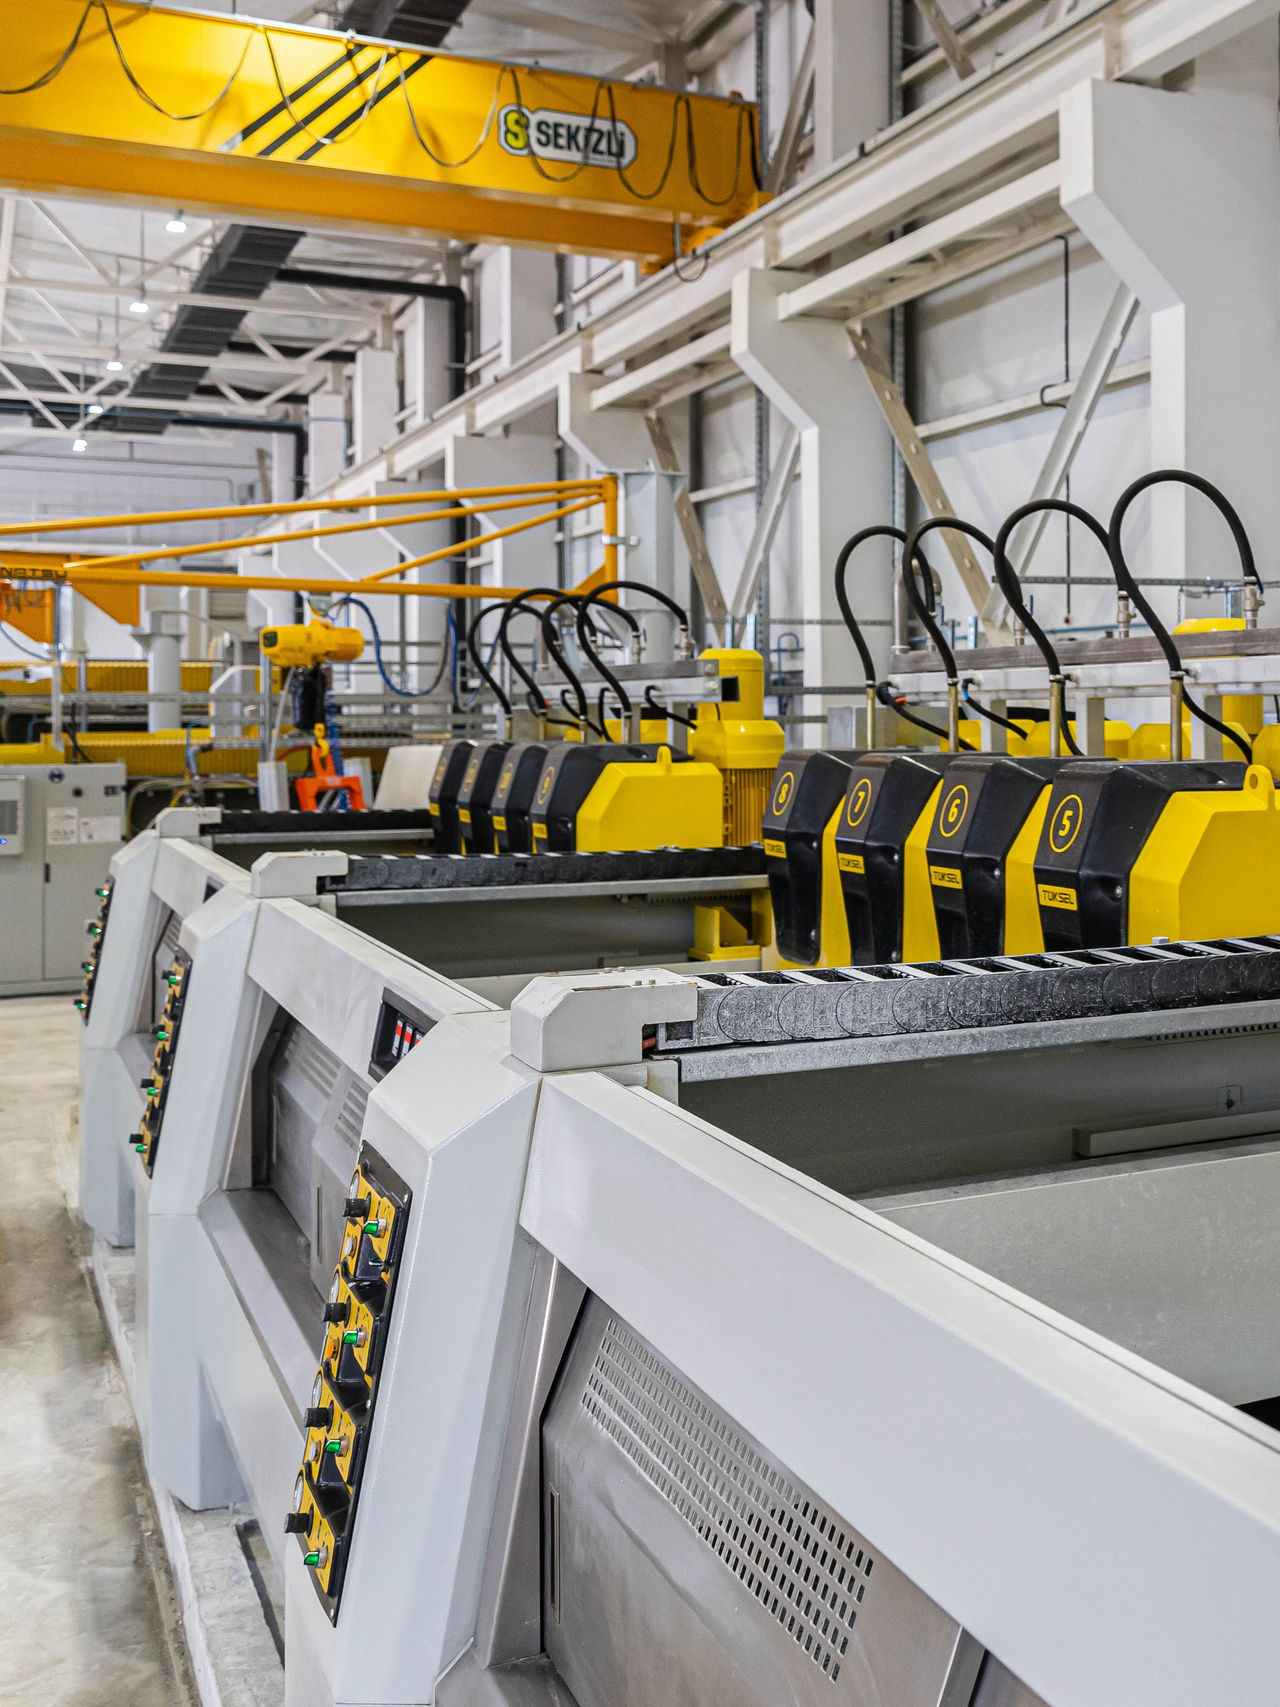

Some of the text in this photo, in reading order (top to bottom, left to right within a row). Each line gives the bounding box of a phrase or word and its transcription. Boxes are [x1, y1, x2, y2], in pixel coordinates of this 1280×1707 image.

[778, 783, 789, 804] 8
[853, 791, 866, 813] 7
[948, 798, 961, 823] 6
[1058, 809, 1074, 837] 5
